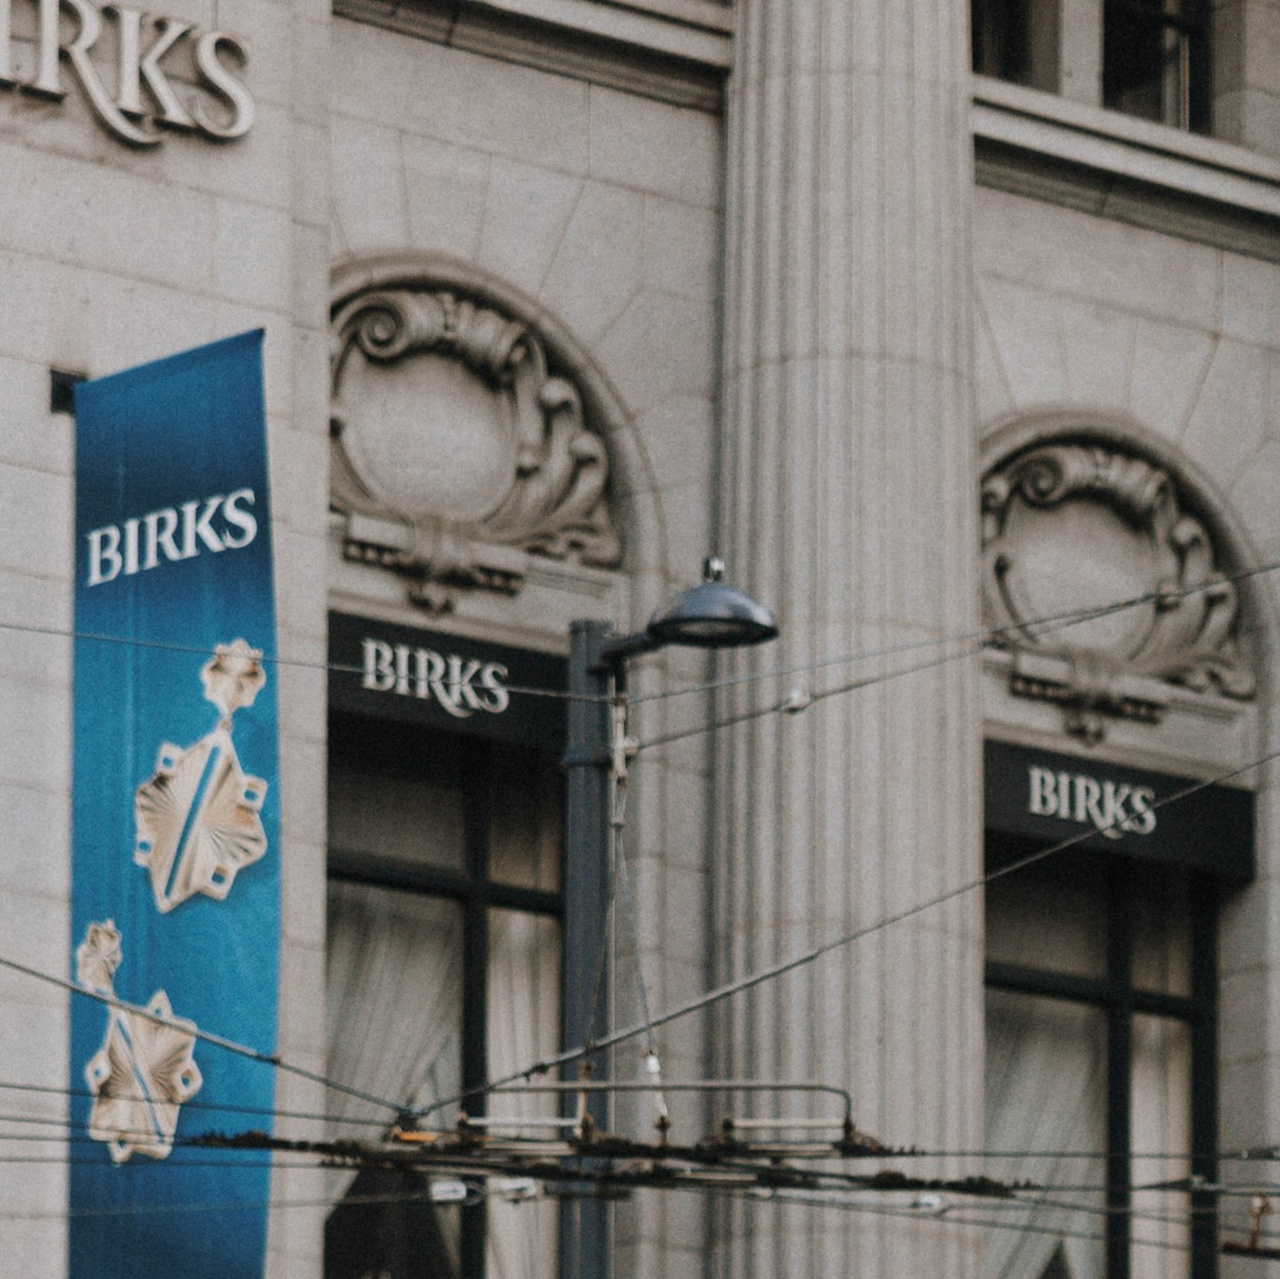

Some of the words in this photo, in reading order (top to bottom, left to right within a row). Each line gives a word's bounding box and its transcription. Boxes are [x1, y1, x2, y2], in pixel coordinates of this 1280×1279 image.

[85, 486, 258, 588] BIRKS
[361, 637, 510, 718] BIRKS
[1029, 765, 1157, 840] BIRKS
